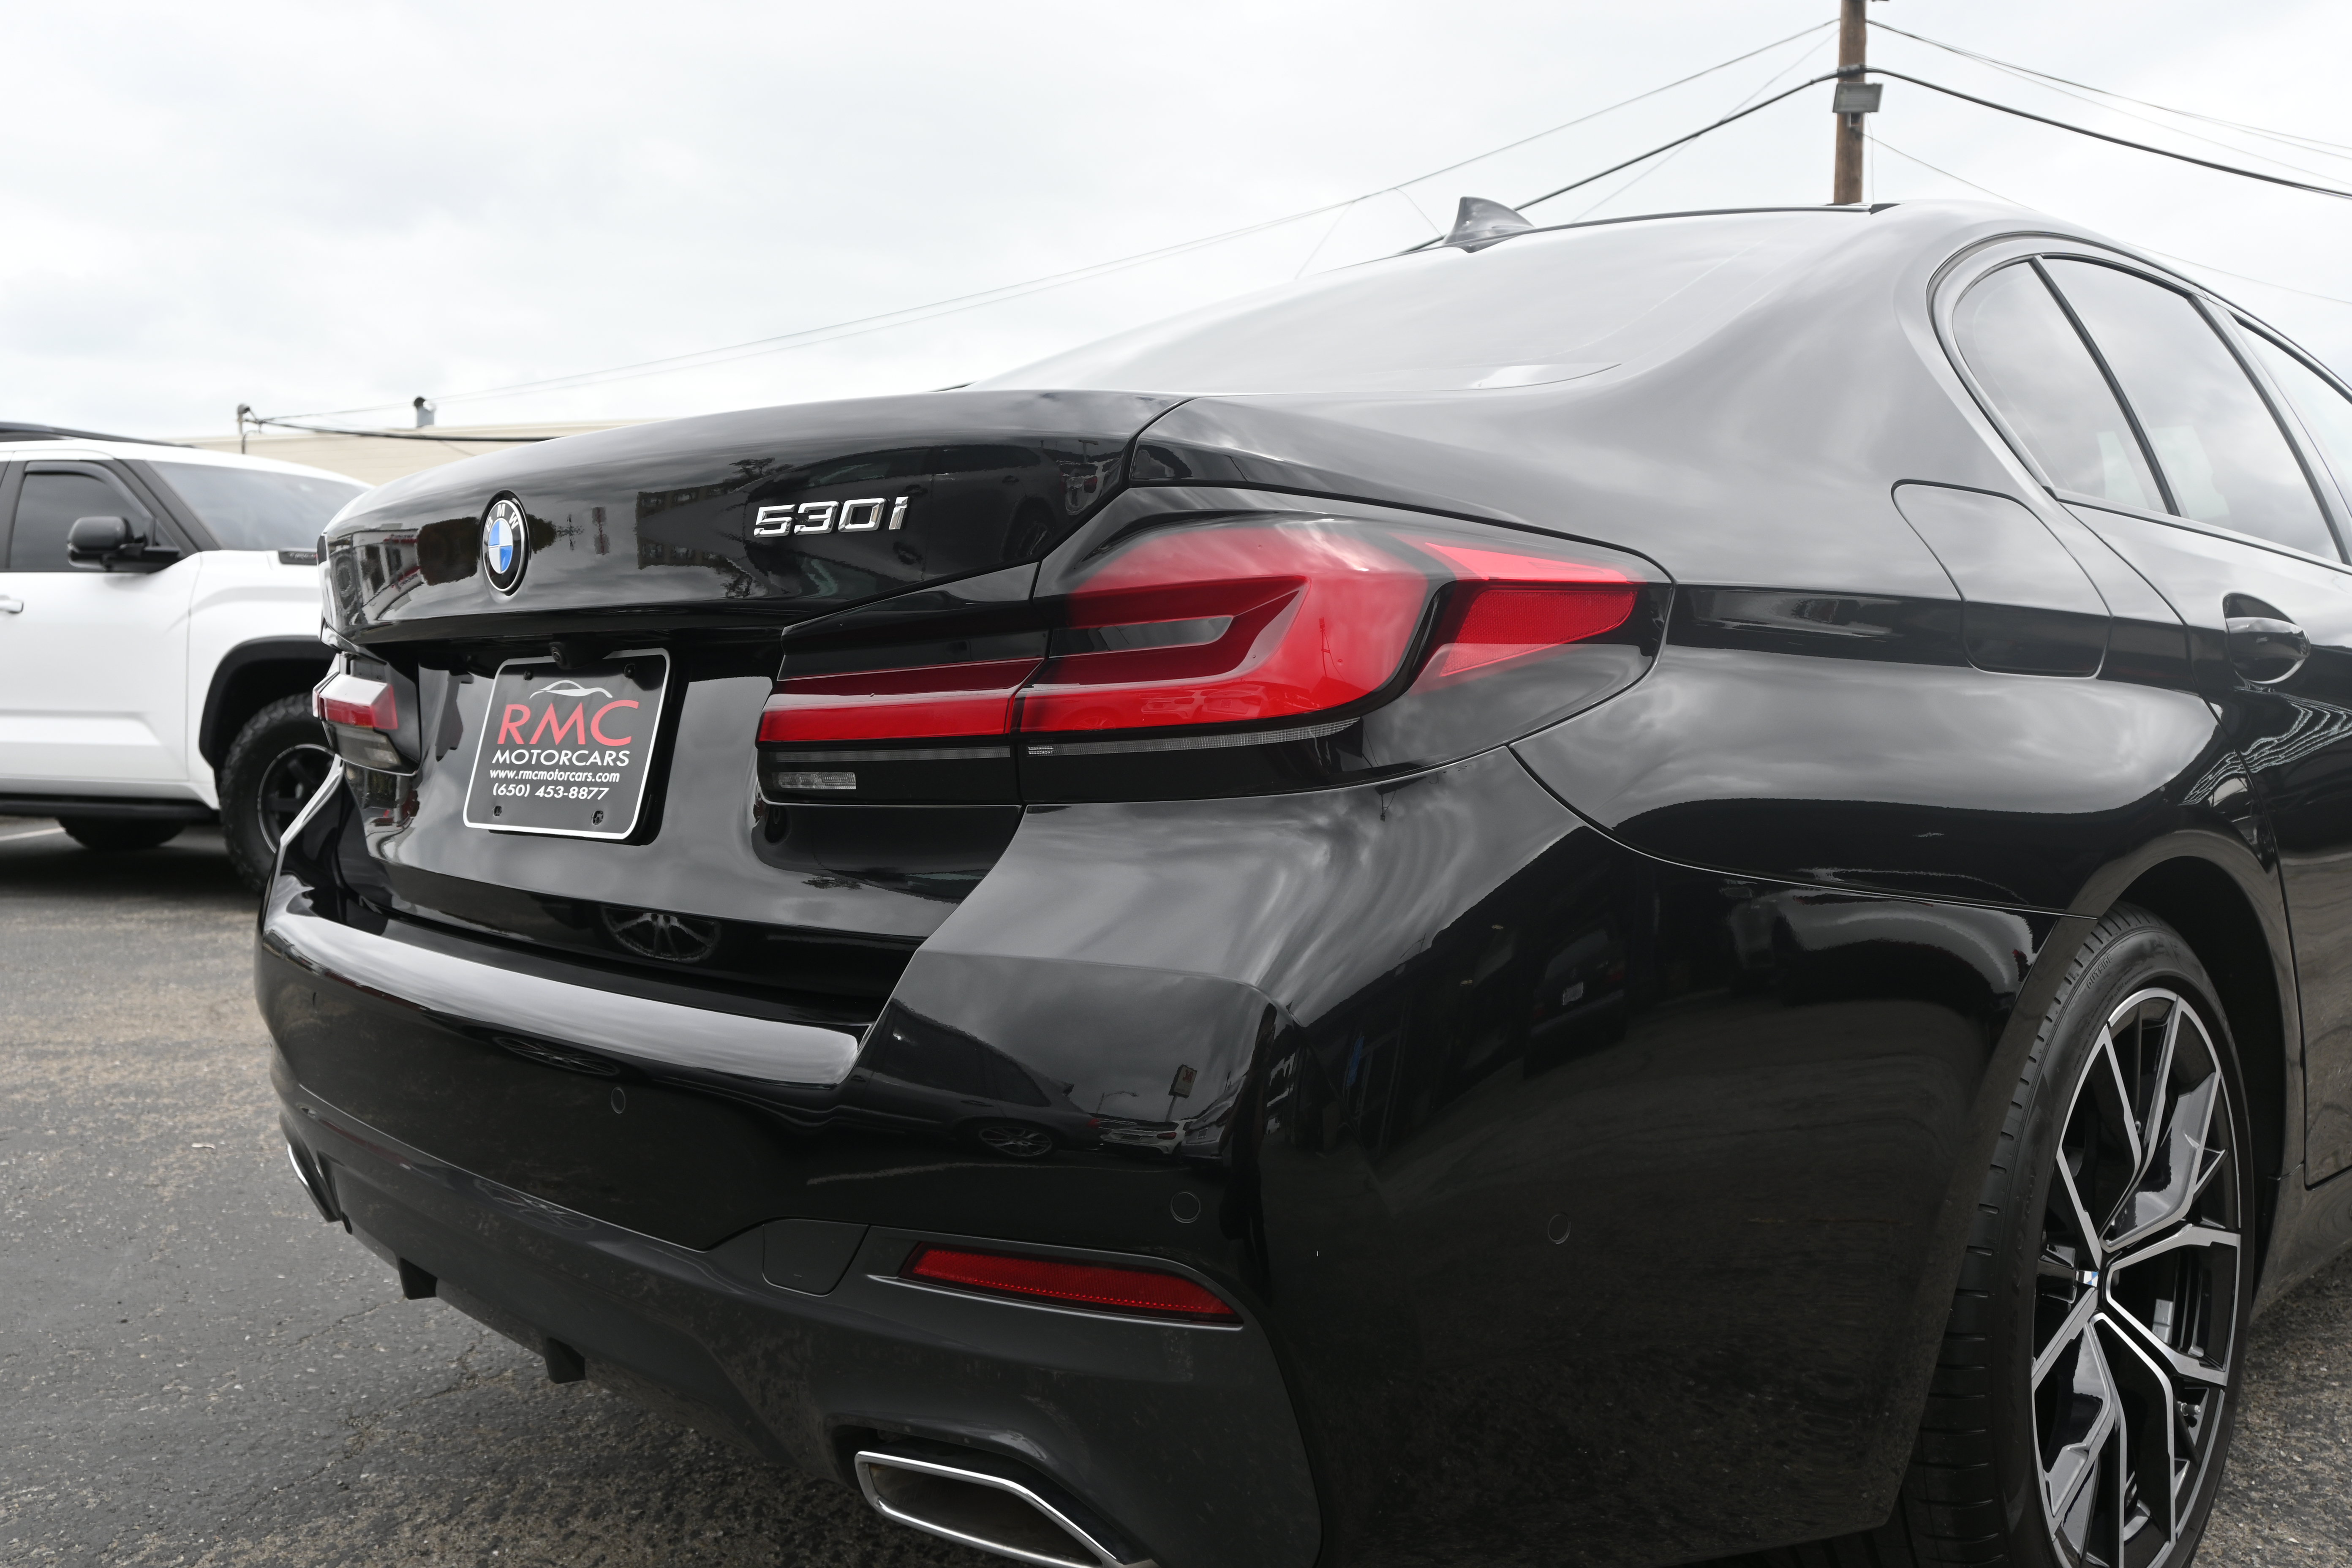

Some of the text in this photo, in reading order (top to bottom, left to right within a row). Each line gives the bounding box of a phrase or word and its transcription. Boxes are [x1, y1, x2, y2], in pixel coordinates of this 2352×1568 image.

[486, 503, 519, 533] BMW
[754, 496, 909, 538] 530i
[497, 700, 639, 746] RMC
[492, 749, 630, 767] MOTORCARS
[490, 768, 620, 782] www.rmcmotorcars.com
[493, 783, 610, 800] (650) 453-8877
